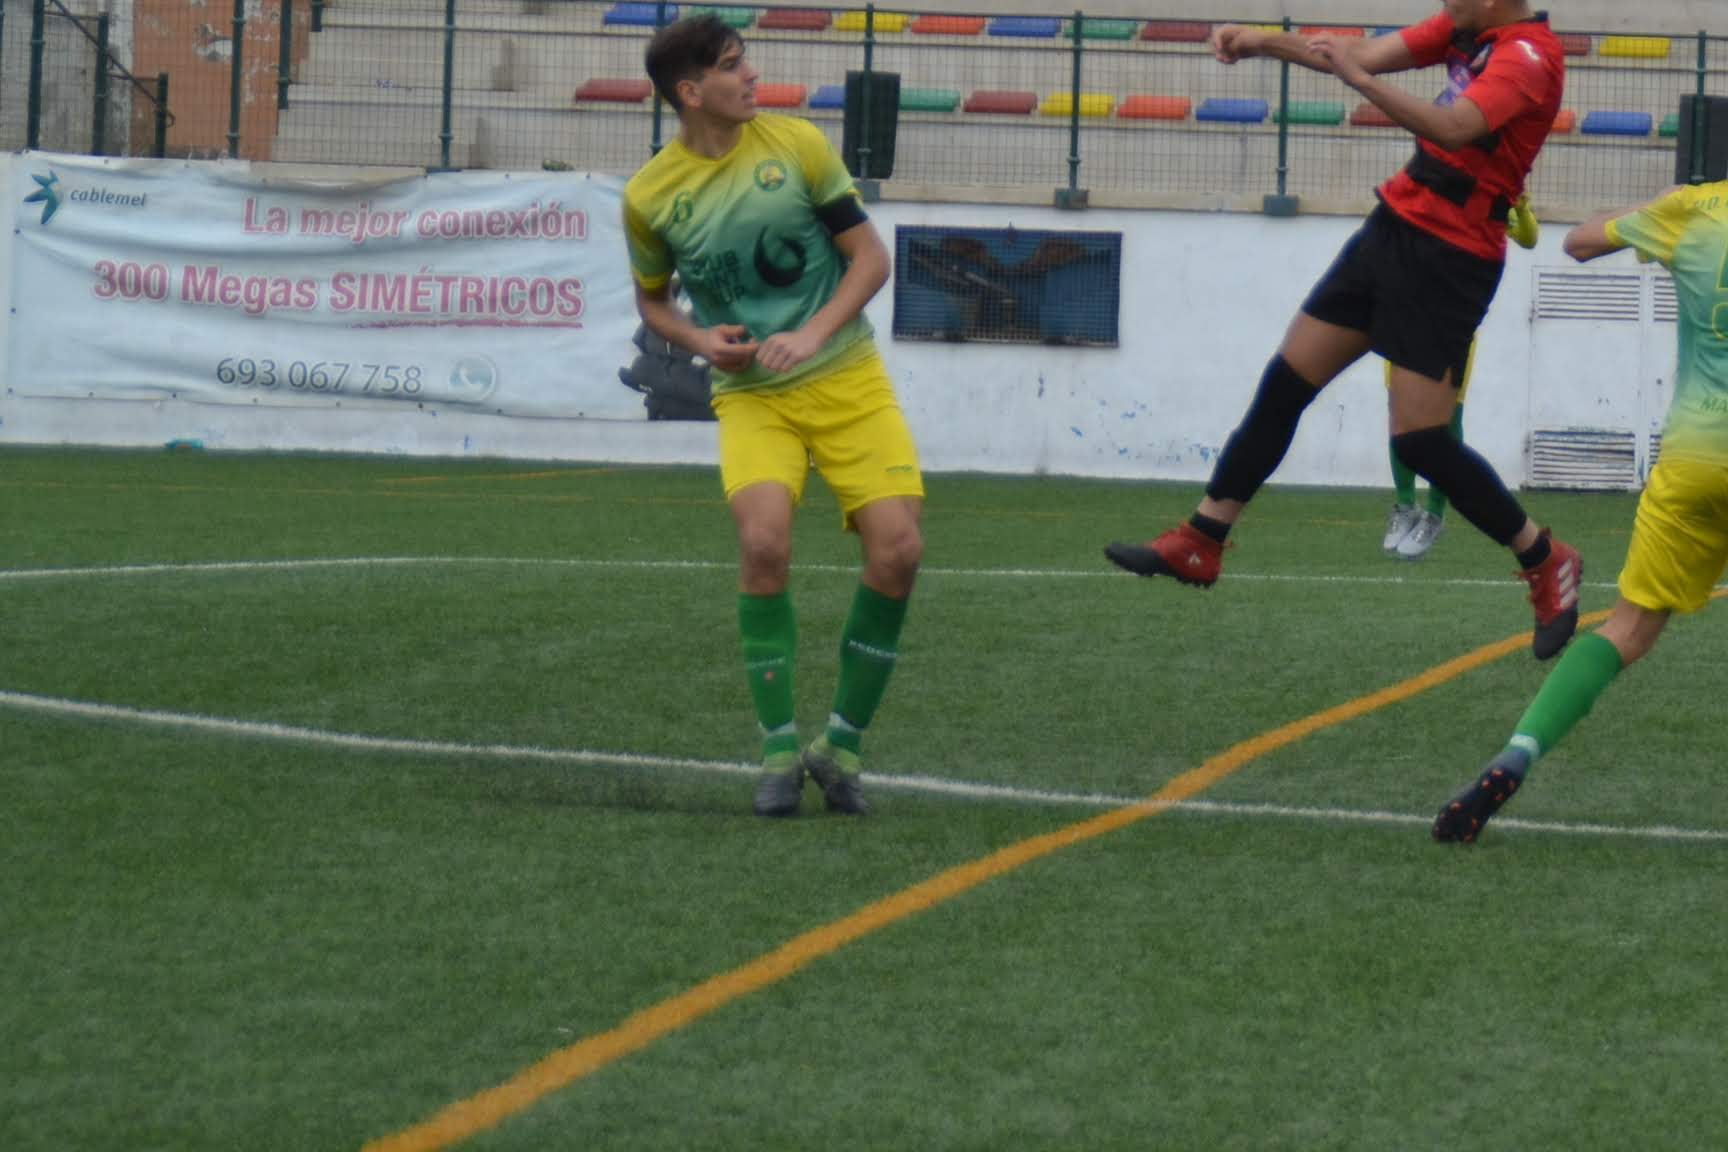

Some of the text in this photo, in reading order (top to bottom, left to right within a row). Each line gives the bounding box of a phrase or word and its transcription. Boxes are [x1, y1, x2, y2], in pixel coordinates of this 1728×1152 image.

[70, 187, 146, 207] cablemel
[243, 198, 587, 244] La mejor conexión
[94, 261, 584, 319] 300 Megas SIMÉTRICOS
[216, 357, 422, 395] 693 067 758
